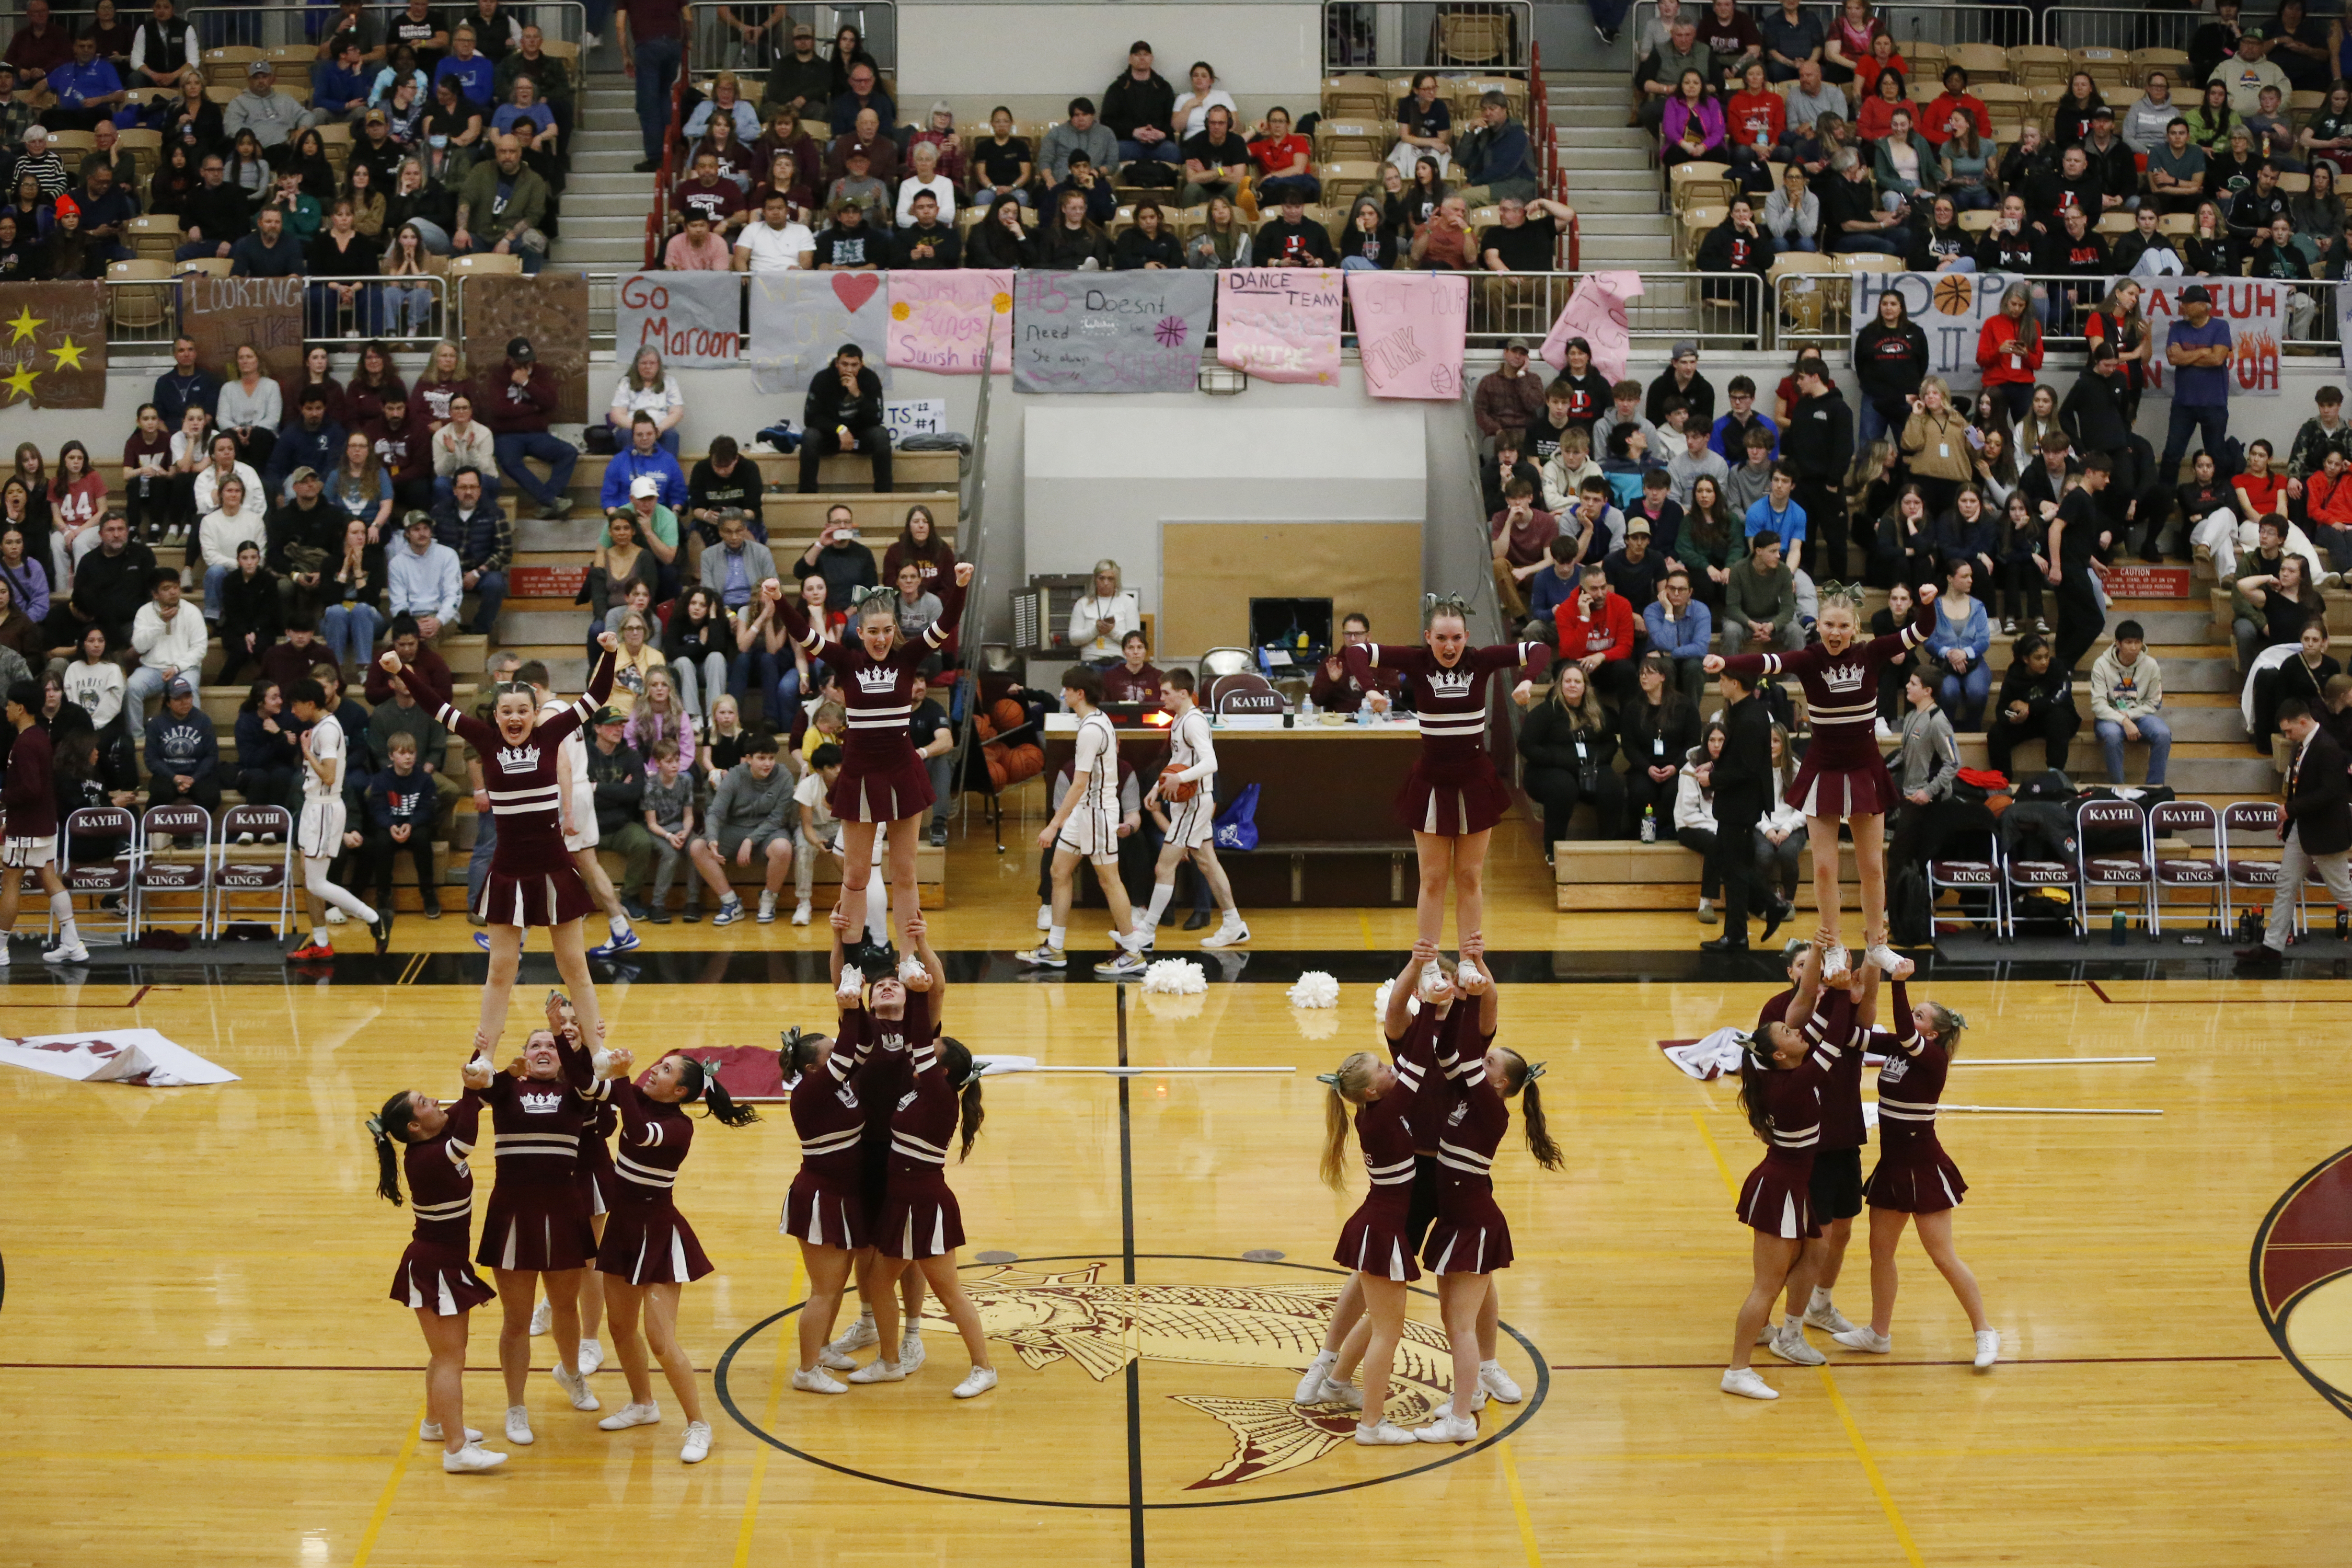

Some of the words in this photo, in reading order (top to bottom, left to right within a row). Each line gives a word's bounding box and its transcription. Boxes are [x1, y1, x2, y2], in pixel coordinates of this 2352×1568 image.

[2000, 251, 2032, 264] MM
[1230, 271, 1292, 290] DANCE
[191, 278, 302, 314] LOOKING
[1019, 274, 1070, 314] #5
[1285, 291, 1340, 307] TEAM
[1365, 281, 1414, 314] GET
[1429, 284, 1466, 316] YOUR
[917, 304, 984, 342] Kings
[641, 317, 740, 359] Maroon
[900, 334, 960, 366] Swish
[1361, 325, 1427, 390] PINK
[887, 408, 911, 424] TS
[914, 418, 936, 434] #1
[61, 491, 93, 522] 44
[551, 567, 582, 575] CAUTION
[2120, 568, 2150, 577] CAUTION
[76, 678, 103, 688] PARIS
[1232, 696, 1274, 708] KAYHI
[159, 725, 203, 745] SEATTLE
[78, 814, 122, 827] KAYHI
[154, 812, 198, 825] KAYHI
[236, 812, 280, 825] KAYHI
[2089, 809, 2134, 821] KAYHI
[2162, 810, 2205, 822] KAYHI
[146, 875, 185, 886] KINGS
[225, 875, 263, 886] KINGS
[1953, 871, 1991, 882] KINGS
[2030, 871, 2068, 881] KINGS
[2104, 870, 2141, 881] KINGS
[2176, 871, 2214, 882] KINGS
[2250, 872, 2278, 882] KING
[73, 878, 111, 887] KINGS
